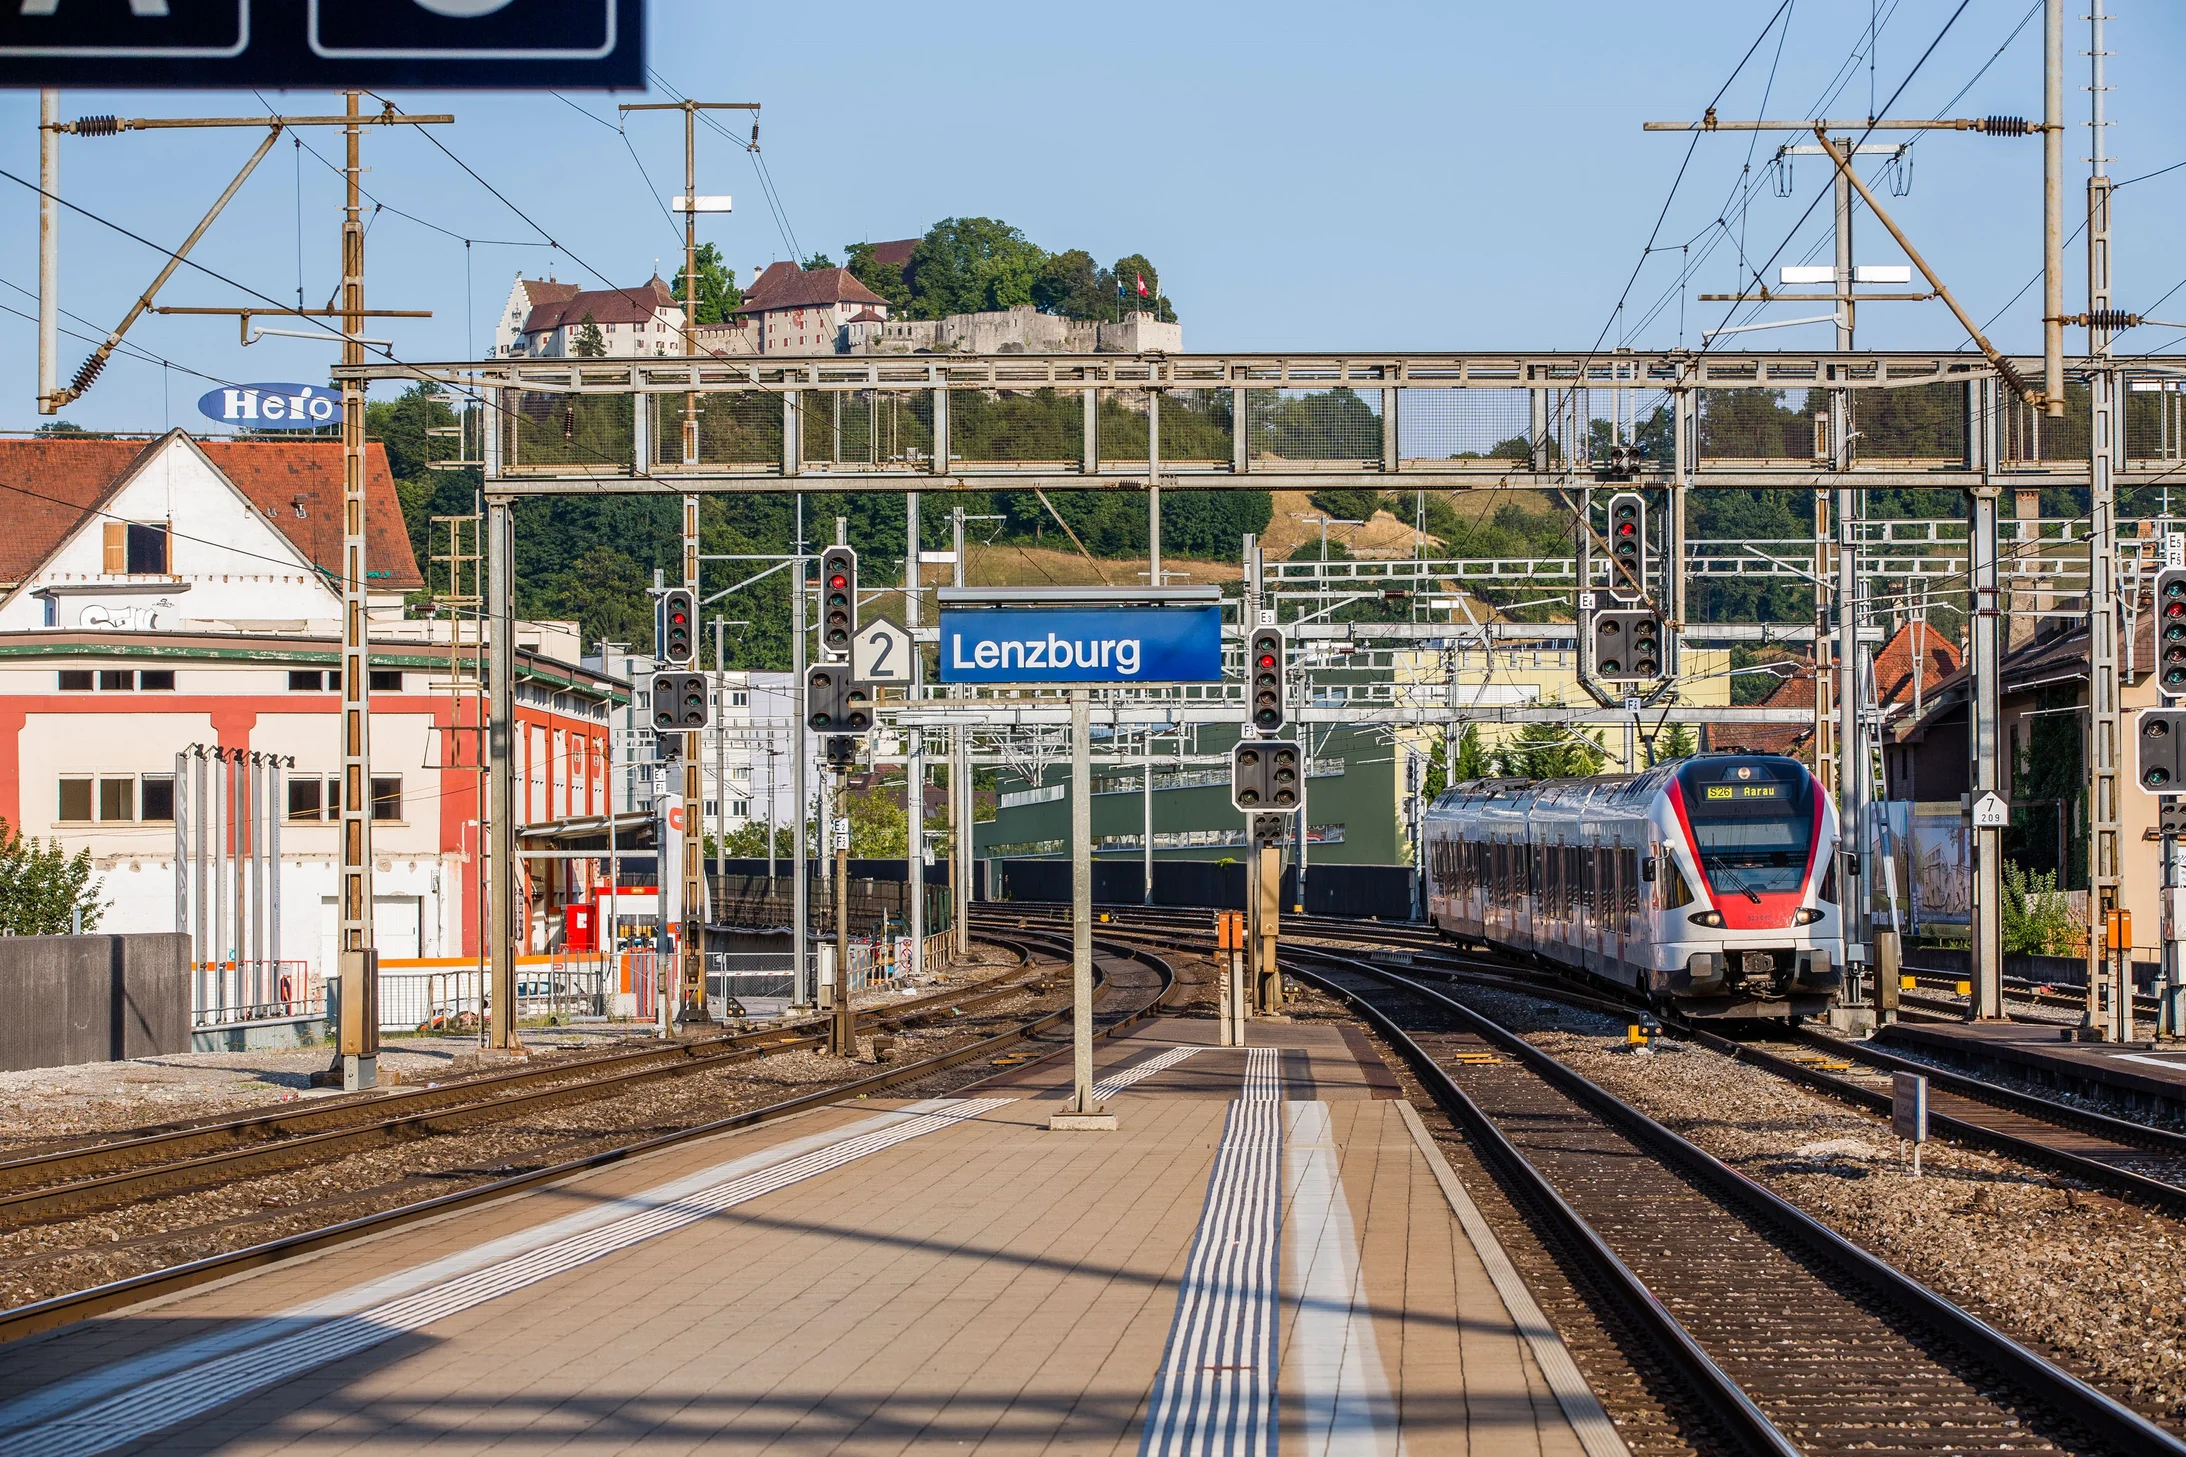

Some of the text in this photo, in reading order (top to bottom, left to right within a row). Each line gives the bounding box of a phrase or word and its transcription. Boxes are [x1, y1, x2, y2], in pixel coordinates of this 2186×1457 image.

[222, 387, 333, 420] Hero
[869, 631, 895, 677] 2
[953, 633, 1140, 675] Lenzburg
[1710, 786, 1776, 797] S26 Aarau
[1986, 798, 1995, 812] 7
[1981, 813, 2001, 823] 209
